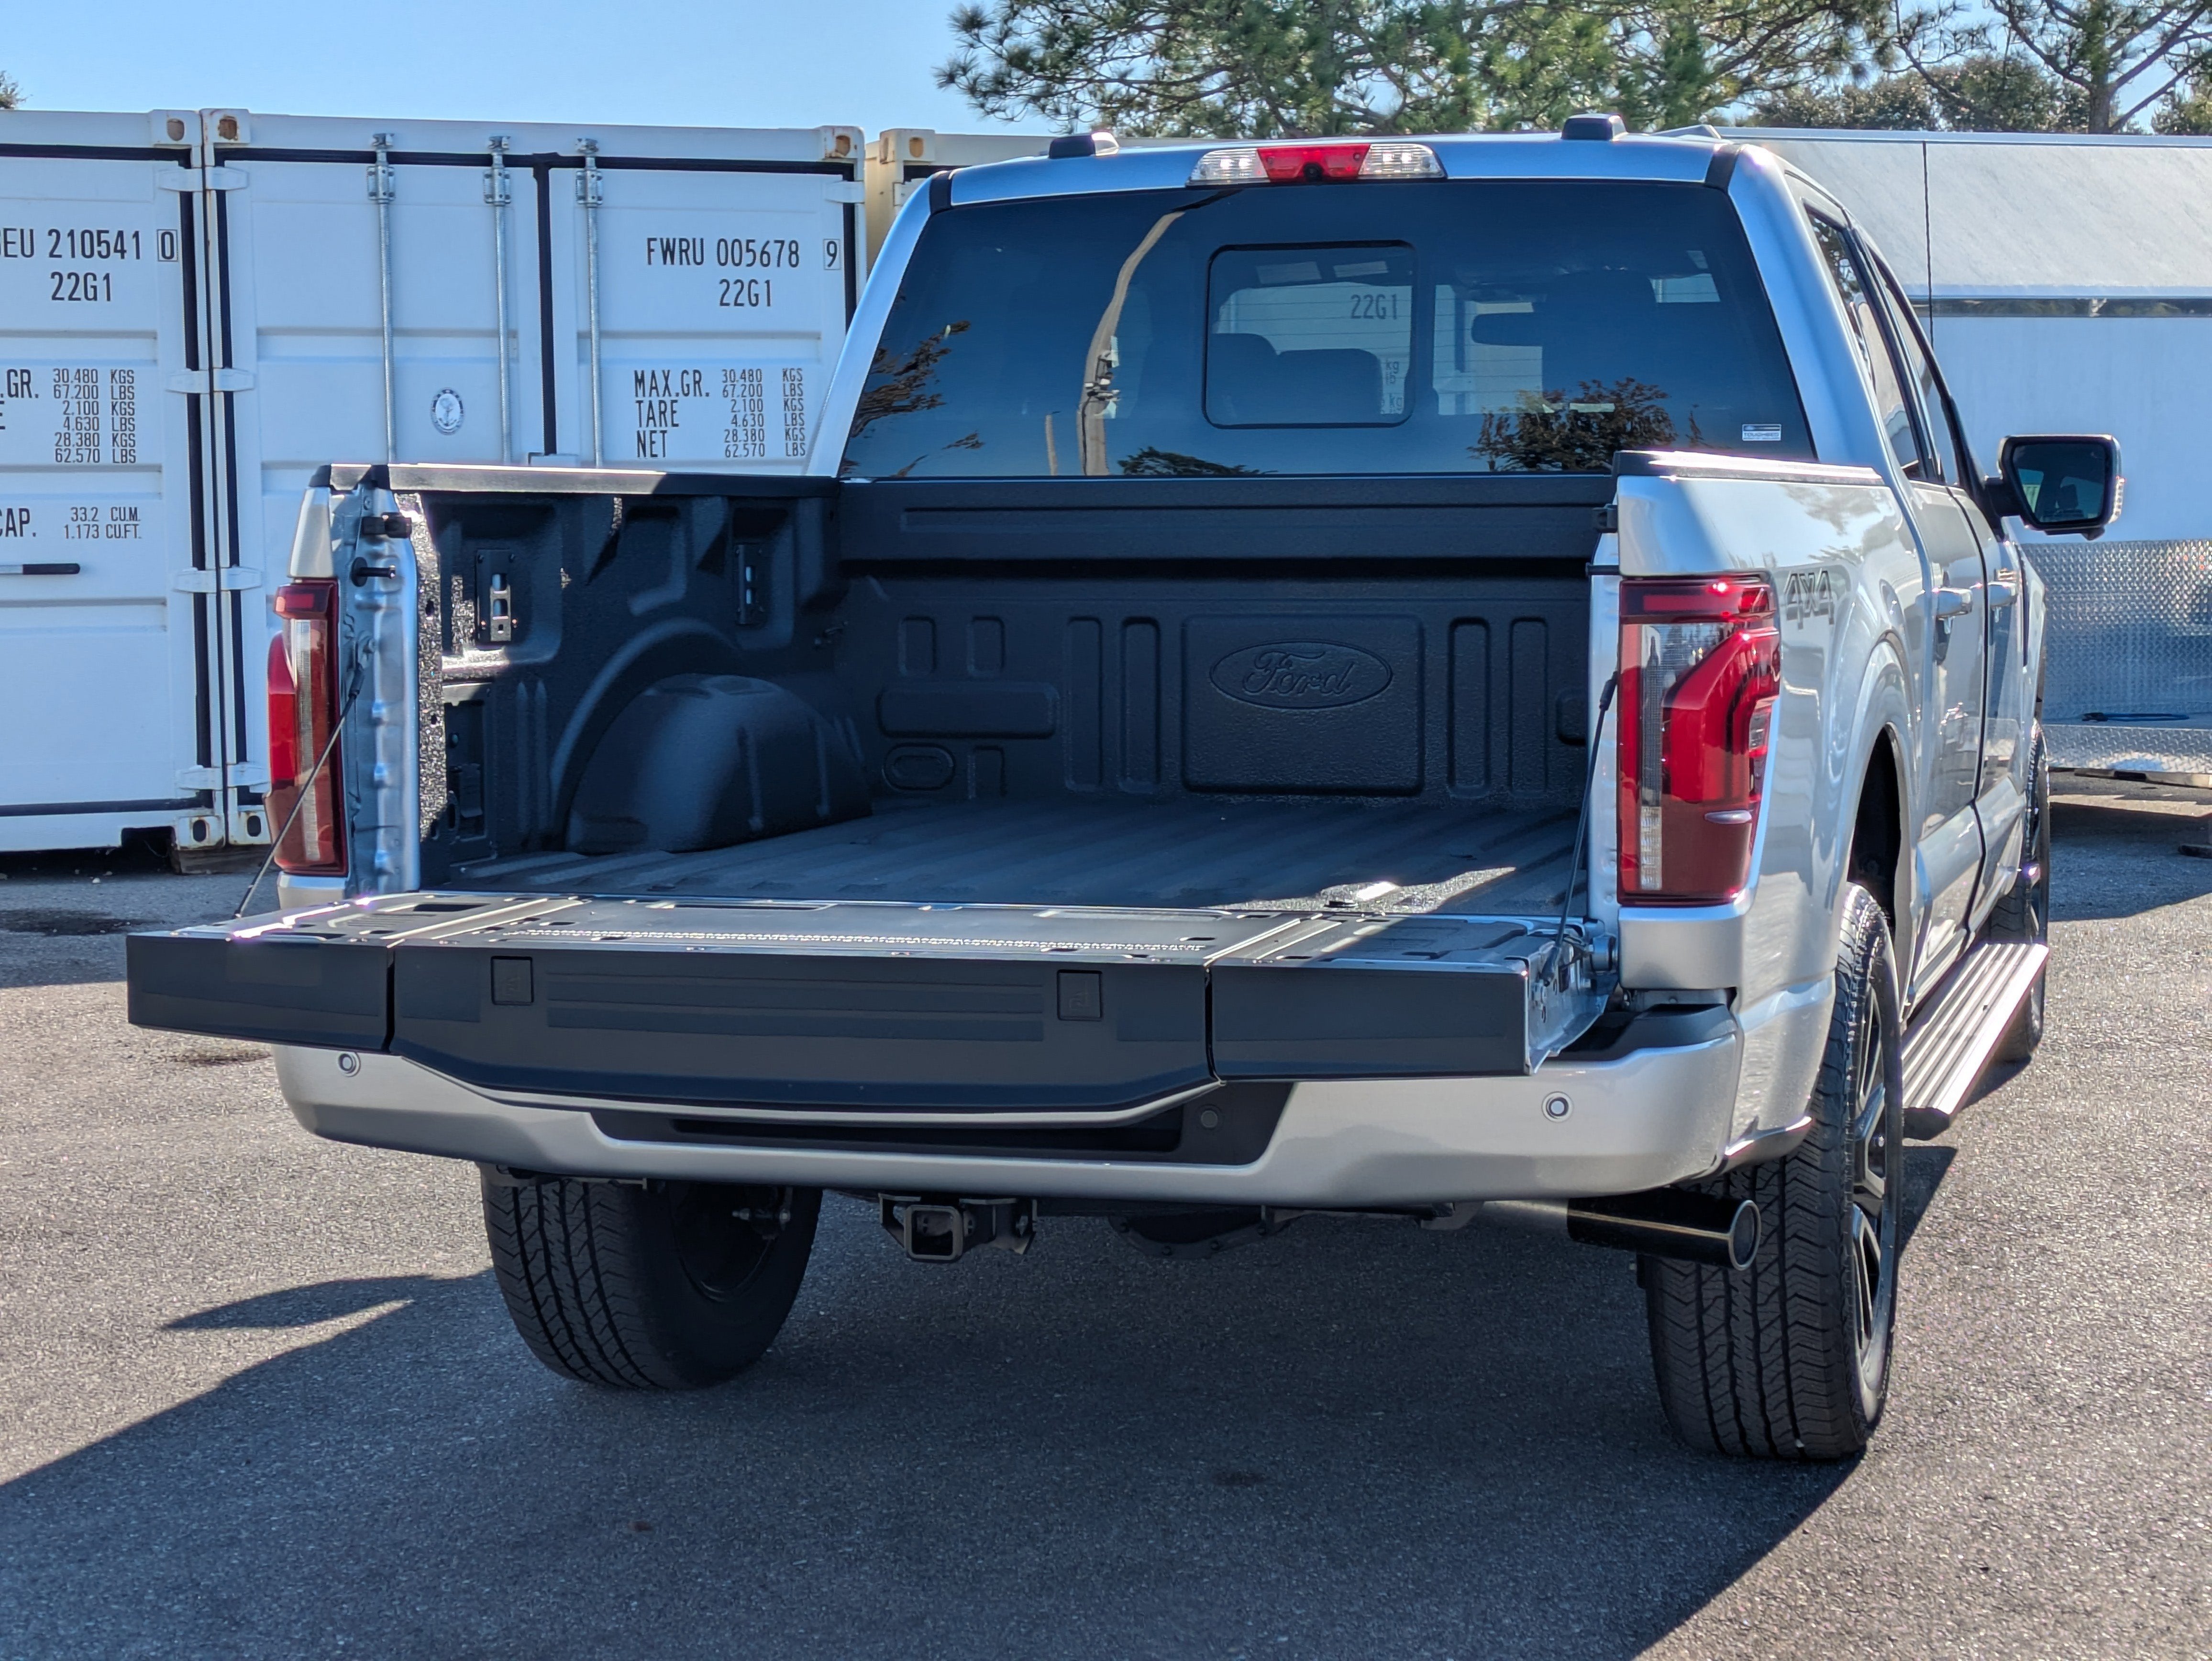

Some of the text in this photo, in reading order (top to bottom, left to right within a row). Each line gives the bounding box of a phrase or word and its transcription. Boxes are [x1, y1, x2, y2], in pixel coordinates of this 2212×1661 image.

[0, 228, 34, 258] EU
[47, 229, 140, 260] 210541
[647, 237, 838, 268] FWRU 005678 9
[50, 271, 111, 302] 22G1
[719, 278, 771, 307] 22G1
[1350, 294, 1398, 321] 22G1
[53, 368, 134, 385] 30.480 KGS
[722, 367, 803, 383] 30.480 KGS
[634, 369, 709, 398] MAX.GR.
[722, 382, 804, 398] 67.200 LBS
[53, 384, 135, 400] 67.200 LBS
[62, 400, 135, 416] 2.100 KGS
[635, 399, 679, 428] TARE
[730, 398, 804, 413] 2.100 KGS
[63, 416, 135, 432] 4.630 LBS
[730, 412, 805, 428] 4.630 LBS
[54, 432, 136, 448] 28.380 KGS
[724, 427, 806, 443] 28.380 KGS
[636, 430, 667, 458] NET
[725, 442, 806, 458] 62.570 LBS
[55, 448, 136, 464] 62.570 LBS
[0, 508, 36, 537] AP.
[70, 507, 99, 522] 33.2
[64, 523, 100, 539] 1.173
[1243, 650, 1356, 696] Ford
